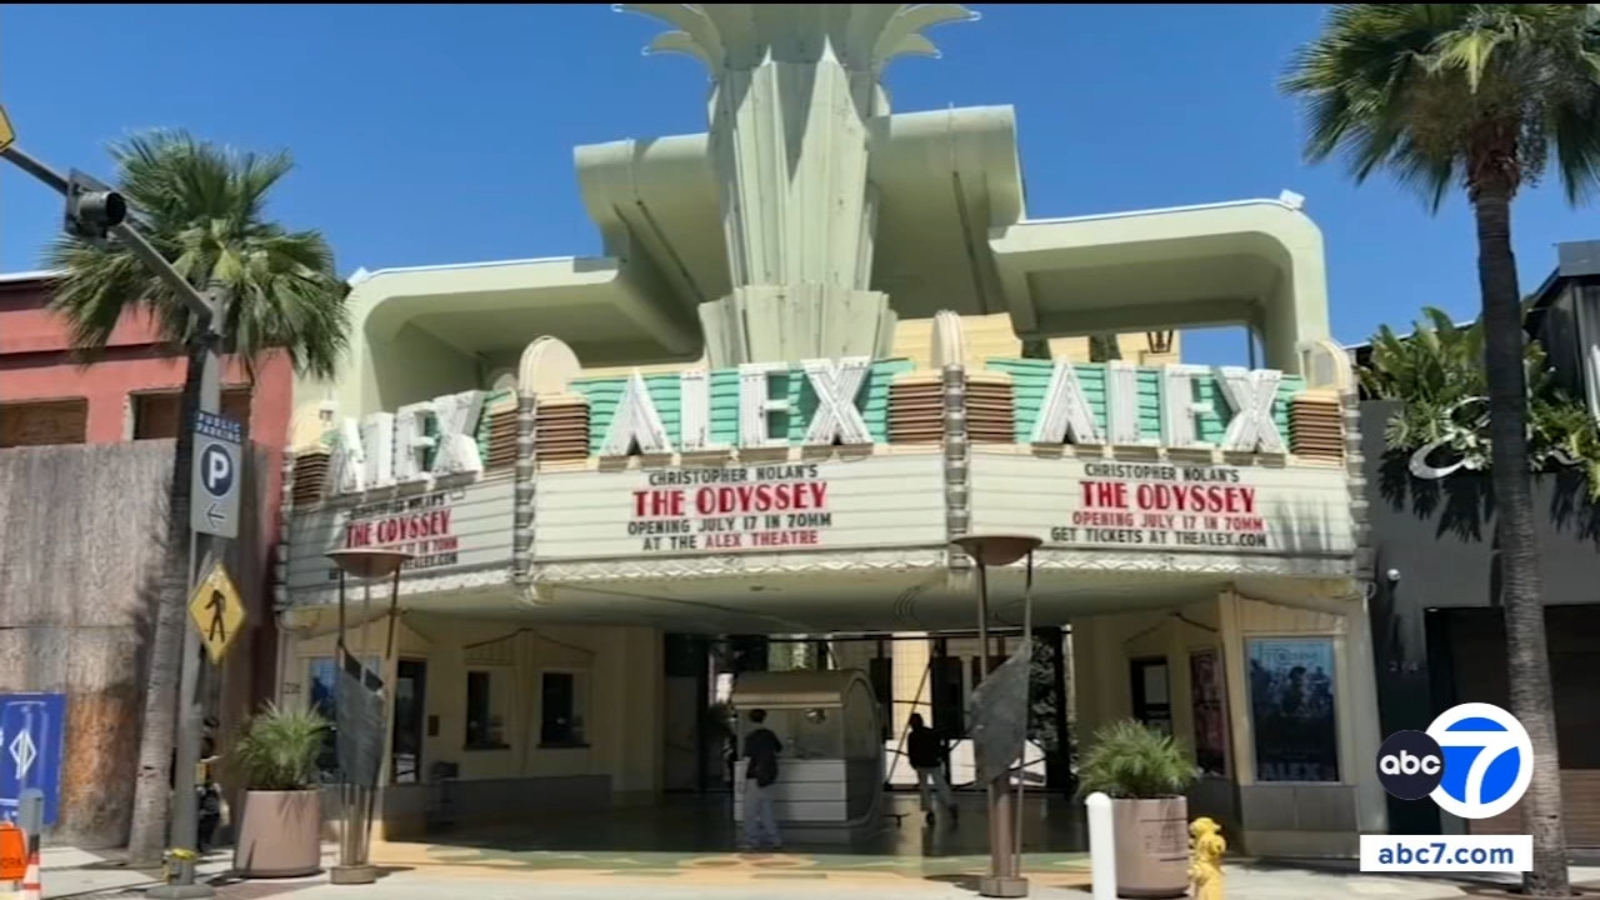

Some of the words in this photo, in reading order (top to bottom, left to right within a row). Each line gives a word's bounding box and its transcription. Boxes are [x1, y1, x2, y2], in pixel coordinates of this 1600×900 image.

[599, 355, 875, 458] ALEX
[1030, 357, 1290, 456] ALEX
[196, 423, 242, 443] PARKING
[197, 412, 242, 432] PUBLIC
[334, 390, 484, 494] ALEX
[207, 450, 230, 489] P
[648, 467, 748, 486] CHRISTOPHER
[756, 464, 818, 482] NOLAN'S
[1084, 463, 1177, 481] CHRISTOPHER
[1183, 466, 1241, 483] NOLAN'S
[633, 489, 686, 517] THE
[696, 481, 828, 515] ODYSSEY
[1080, 480, 1129, 509] THE
[1137, 484, 1257, 514] ODYSSEY
[346, 523, 374, 549] THE
[377, 509, 452, 543] ODYSSEY
[628, 519, 691, 536] OPENING
[697, 516, 734, 533] JULY
[743, 515, 758, 531] 17
[764, 514, 781, 530] IN
[1072, 511, 1134, 527] OPENING
[1140, 513, 1174, 529] JULY
[1182, 515, 1197, 530] 17
[1204, 516, 1219, 531] IN
[1224, 516, 1263, 532] 70MM
[642, 535, 664, 552] AT
[670, 533, 698, 550] THE
[705, 532, 742, 549] ALEX
[751, 530, 819, 548] THEATRE
[1051, 526, 1077, 542] GET
[1085, 527, 1143, 544] TICKETS
[1149, 530, 1169, 545] AT
[1175, 530, 1268, 548] THEALEX.COM
[1264, 761, 1322, 781] ALEX
